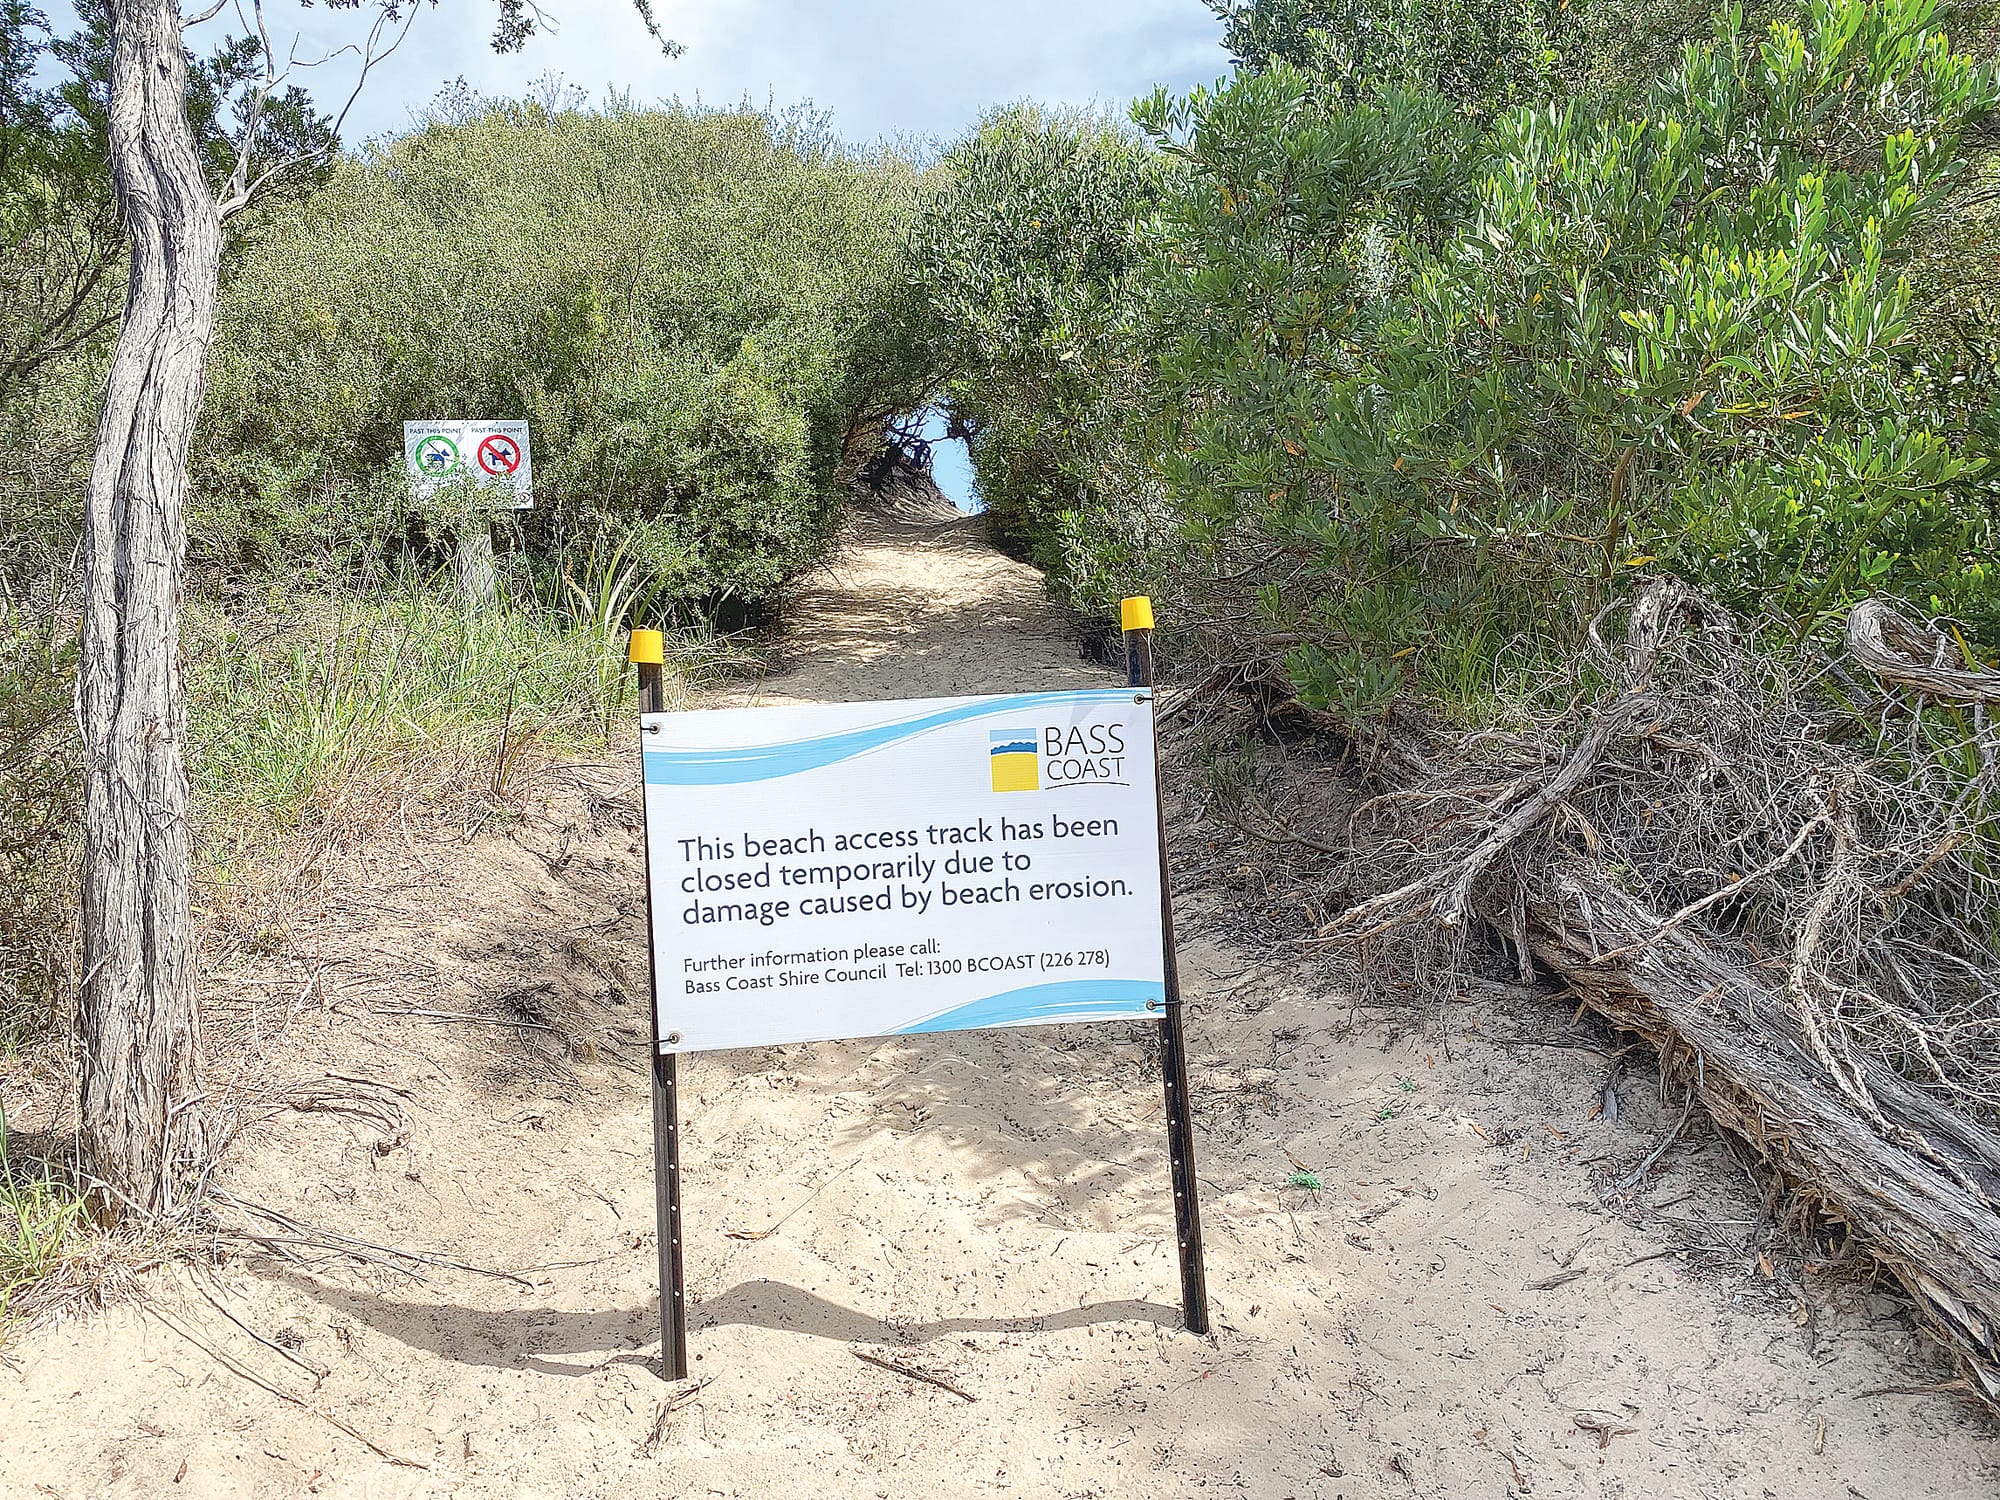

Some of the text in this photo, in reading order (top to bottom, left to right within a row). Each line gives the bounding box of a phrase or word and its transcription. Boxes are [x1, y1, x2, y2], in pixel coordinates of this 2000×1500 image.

[1045, 723, 1124, 757] BASS
[1047, 757, 1125, 780] COAST
[677, 814, 1118, 862] This beach access track has been
[681, 849, 1031, 893] closed temporarily due to
[683, 875, 1133, 926] damage caused by beach erosion.
[684, 938, 940, 973] Further information please call:
[685, 949, 1109, 994] Bass Coast Shire Council Tel: 1300 BCOAST (226 278)
